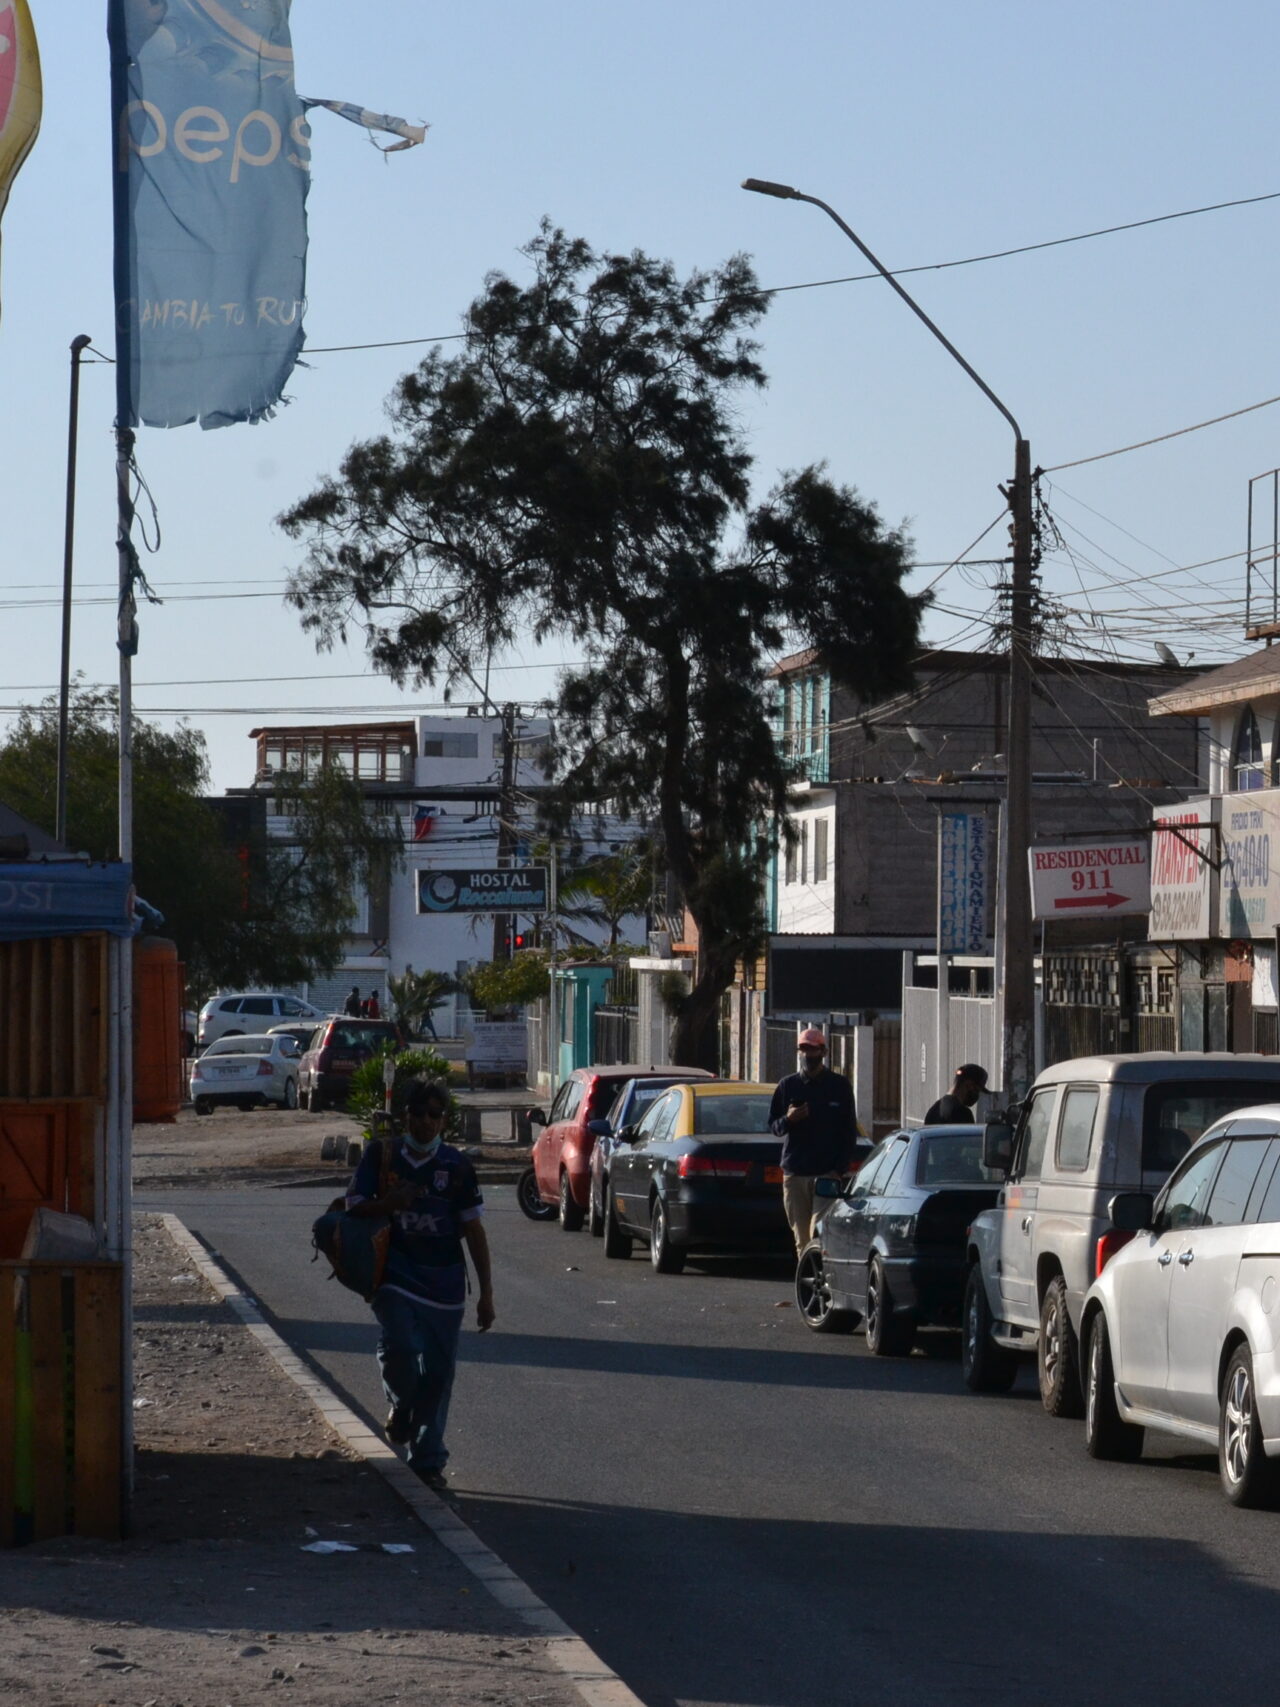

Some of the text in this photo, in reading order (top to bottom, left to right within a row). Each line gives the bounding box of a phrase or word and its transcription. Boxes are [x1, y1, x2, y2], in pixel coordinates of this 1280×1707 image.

[1035, 846, 1145, 870] RESIDENCIAL
[1152, 813, 1200, 886] TRANSFER
[470, 873, 530, 887] HOSTAL
[970, 817, 985, 952] ESTACIONAMIENTO
[1071, 869, 1114, 892] 911
